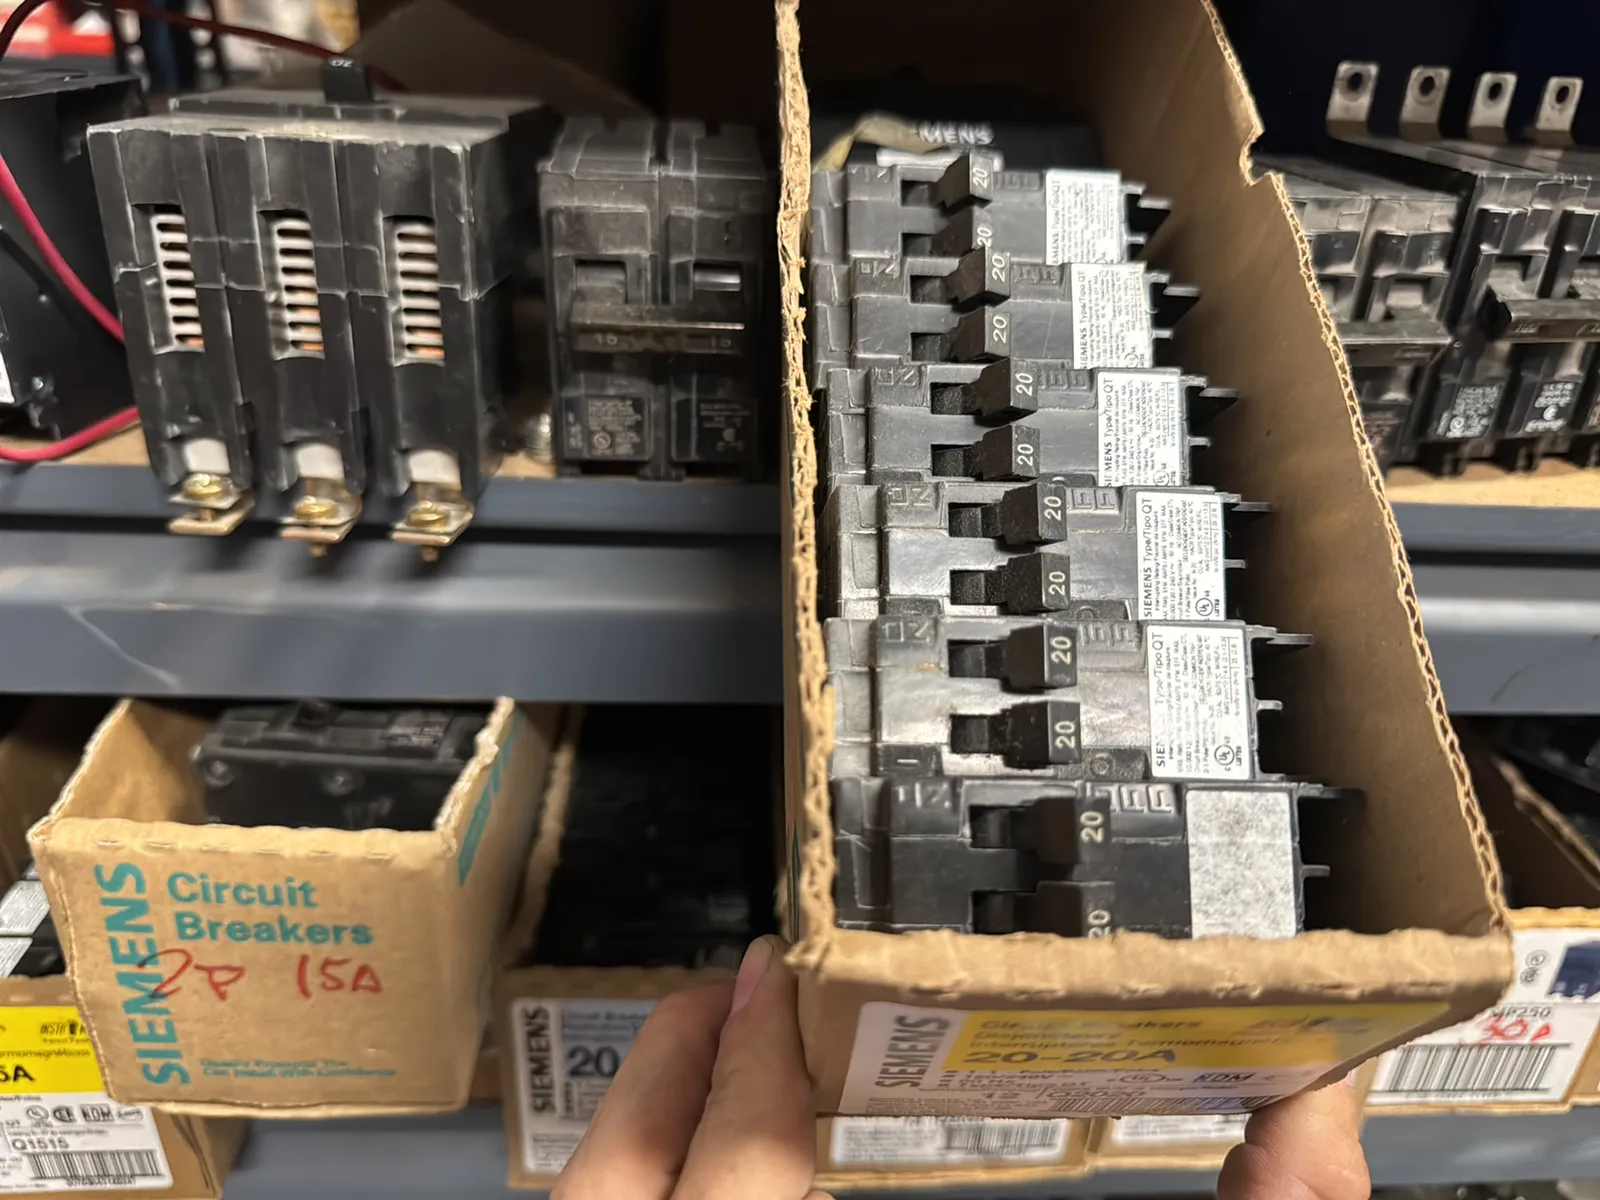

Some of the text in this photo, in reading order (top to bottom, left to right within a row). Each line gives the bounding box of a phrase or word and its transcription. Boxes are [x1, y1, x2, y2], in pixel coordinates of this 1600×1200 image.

[918, 122, 994, 145] MENS
[973, 168, 988, 189] 20
[992, 254, 1006, 283] 20
[1078, 271, 1085, 282] QT
[993, 314, 1008, 344] 20
[1015, 373, 1033, 396] 20
[1103, 378, 1113, 393] QT
[1104, 395, 1113, 438] Type/Tipo
[1016, 443, 1034, 467] 20
[1044, 496, 1062, 521] 20
[1142, 498, 1153, 617] SIEMENS Type/Tipo QT
[1048, 571, 1066, 597] 20
[1051, 635, 1072, 665] 20
[1152, 632, 1163, 650] QT
[1054, 720, 1075, 749] 20
[1080, 810, 1104, 843] 20
[167, 872, 318, 908] Circuit
[174, 911, 374, 945] Breakers
[94, 862, 190, 1086] SIEMENS
[296, 954, 383, 999] 15A
[524, 1005, 557, 1114] SIEMENS
[567, 1045, 620, 1078] 20
[874, 1014, 952, 1088] SIEMENS
[963, 1049, 1176, 1065] 20-20A
